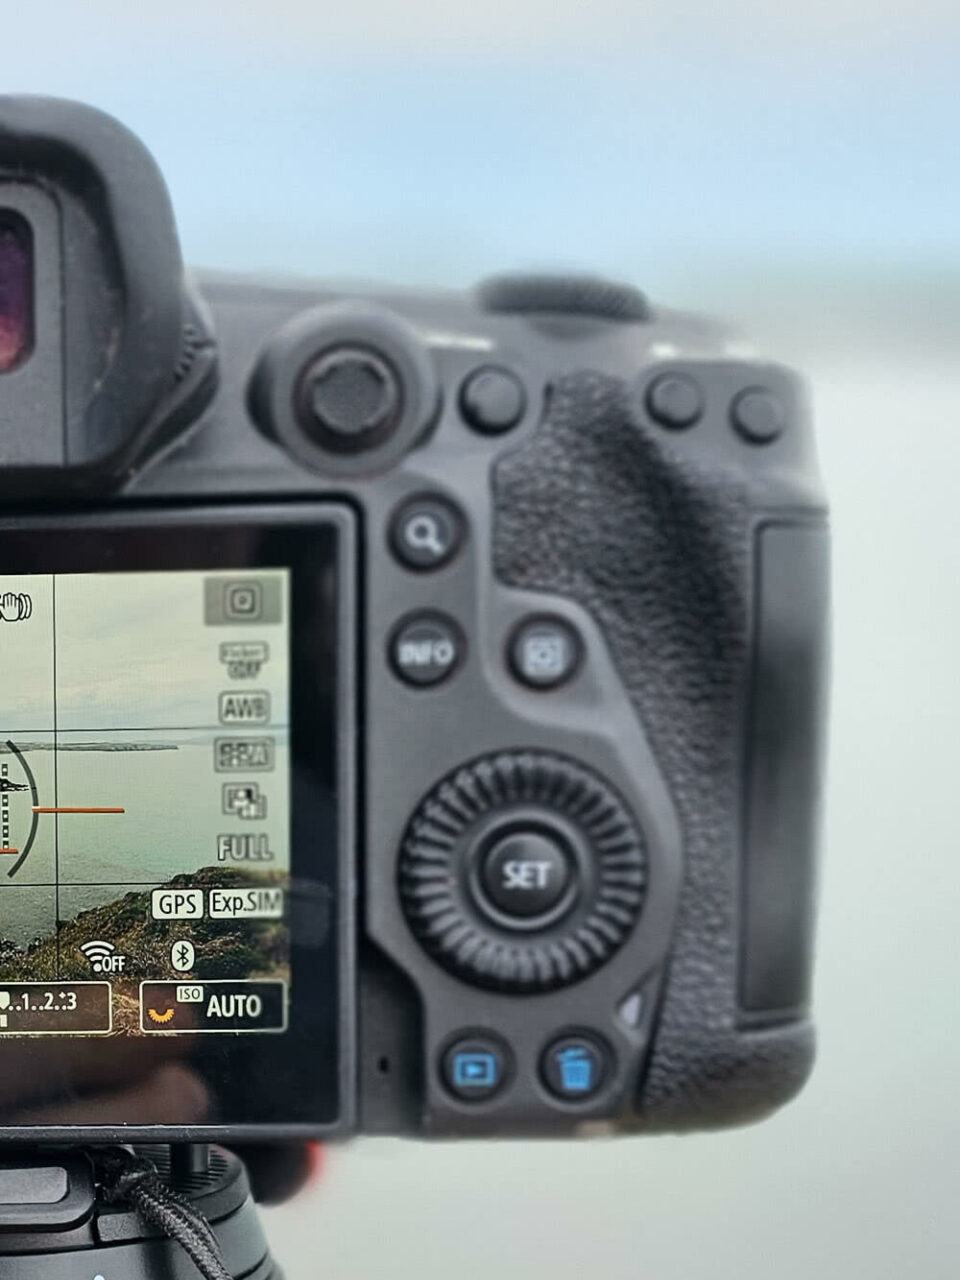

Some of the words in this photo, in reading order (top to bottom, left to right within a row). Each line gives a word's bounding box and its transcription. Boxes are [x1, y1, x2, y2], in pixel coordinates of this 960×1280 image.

[398, 638, 455, 666] INFO
[217, 833, 275, 861] FULL
[501, 860, 552, 889] SET
[159, 894, 197, 915] GPS
[178, 987, 202, 1001] ISO
[206, 994, 263, 1018] AUTO
